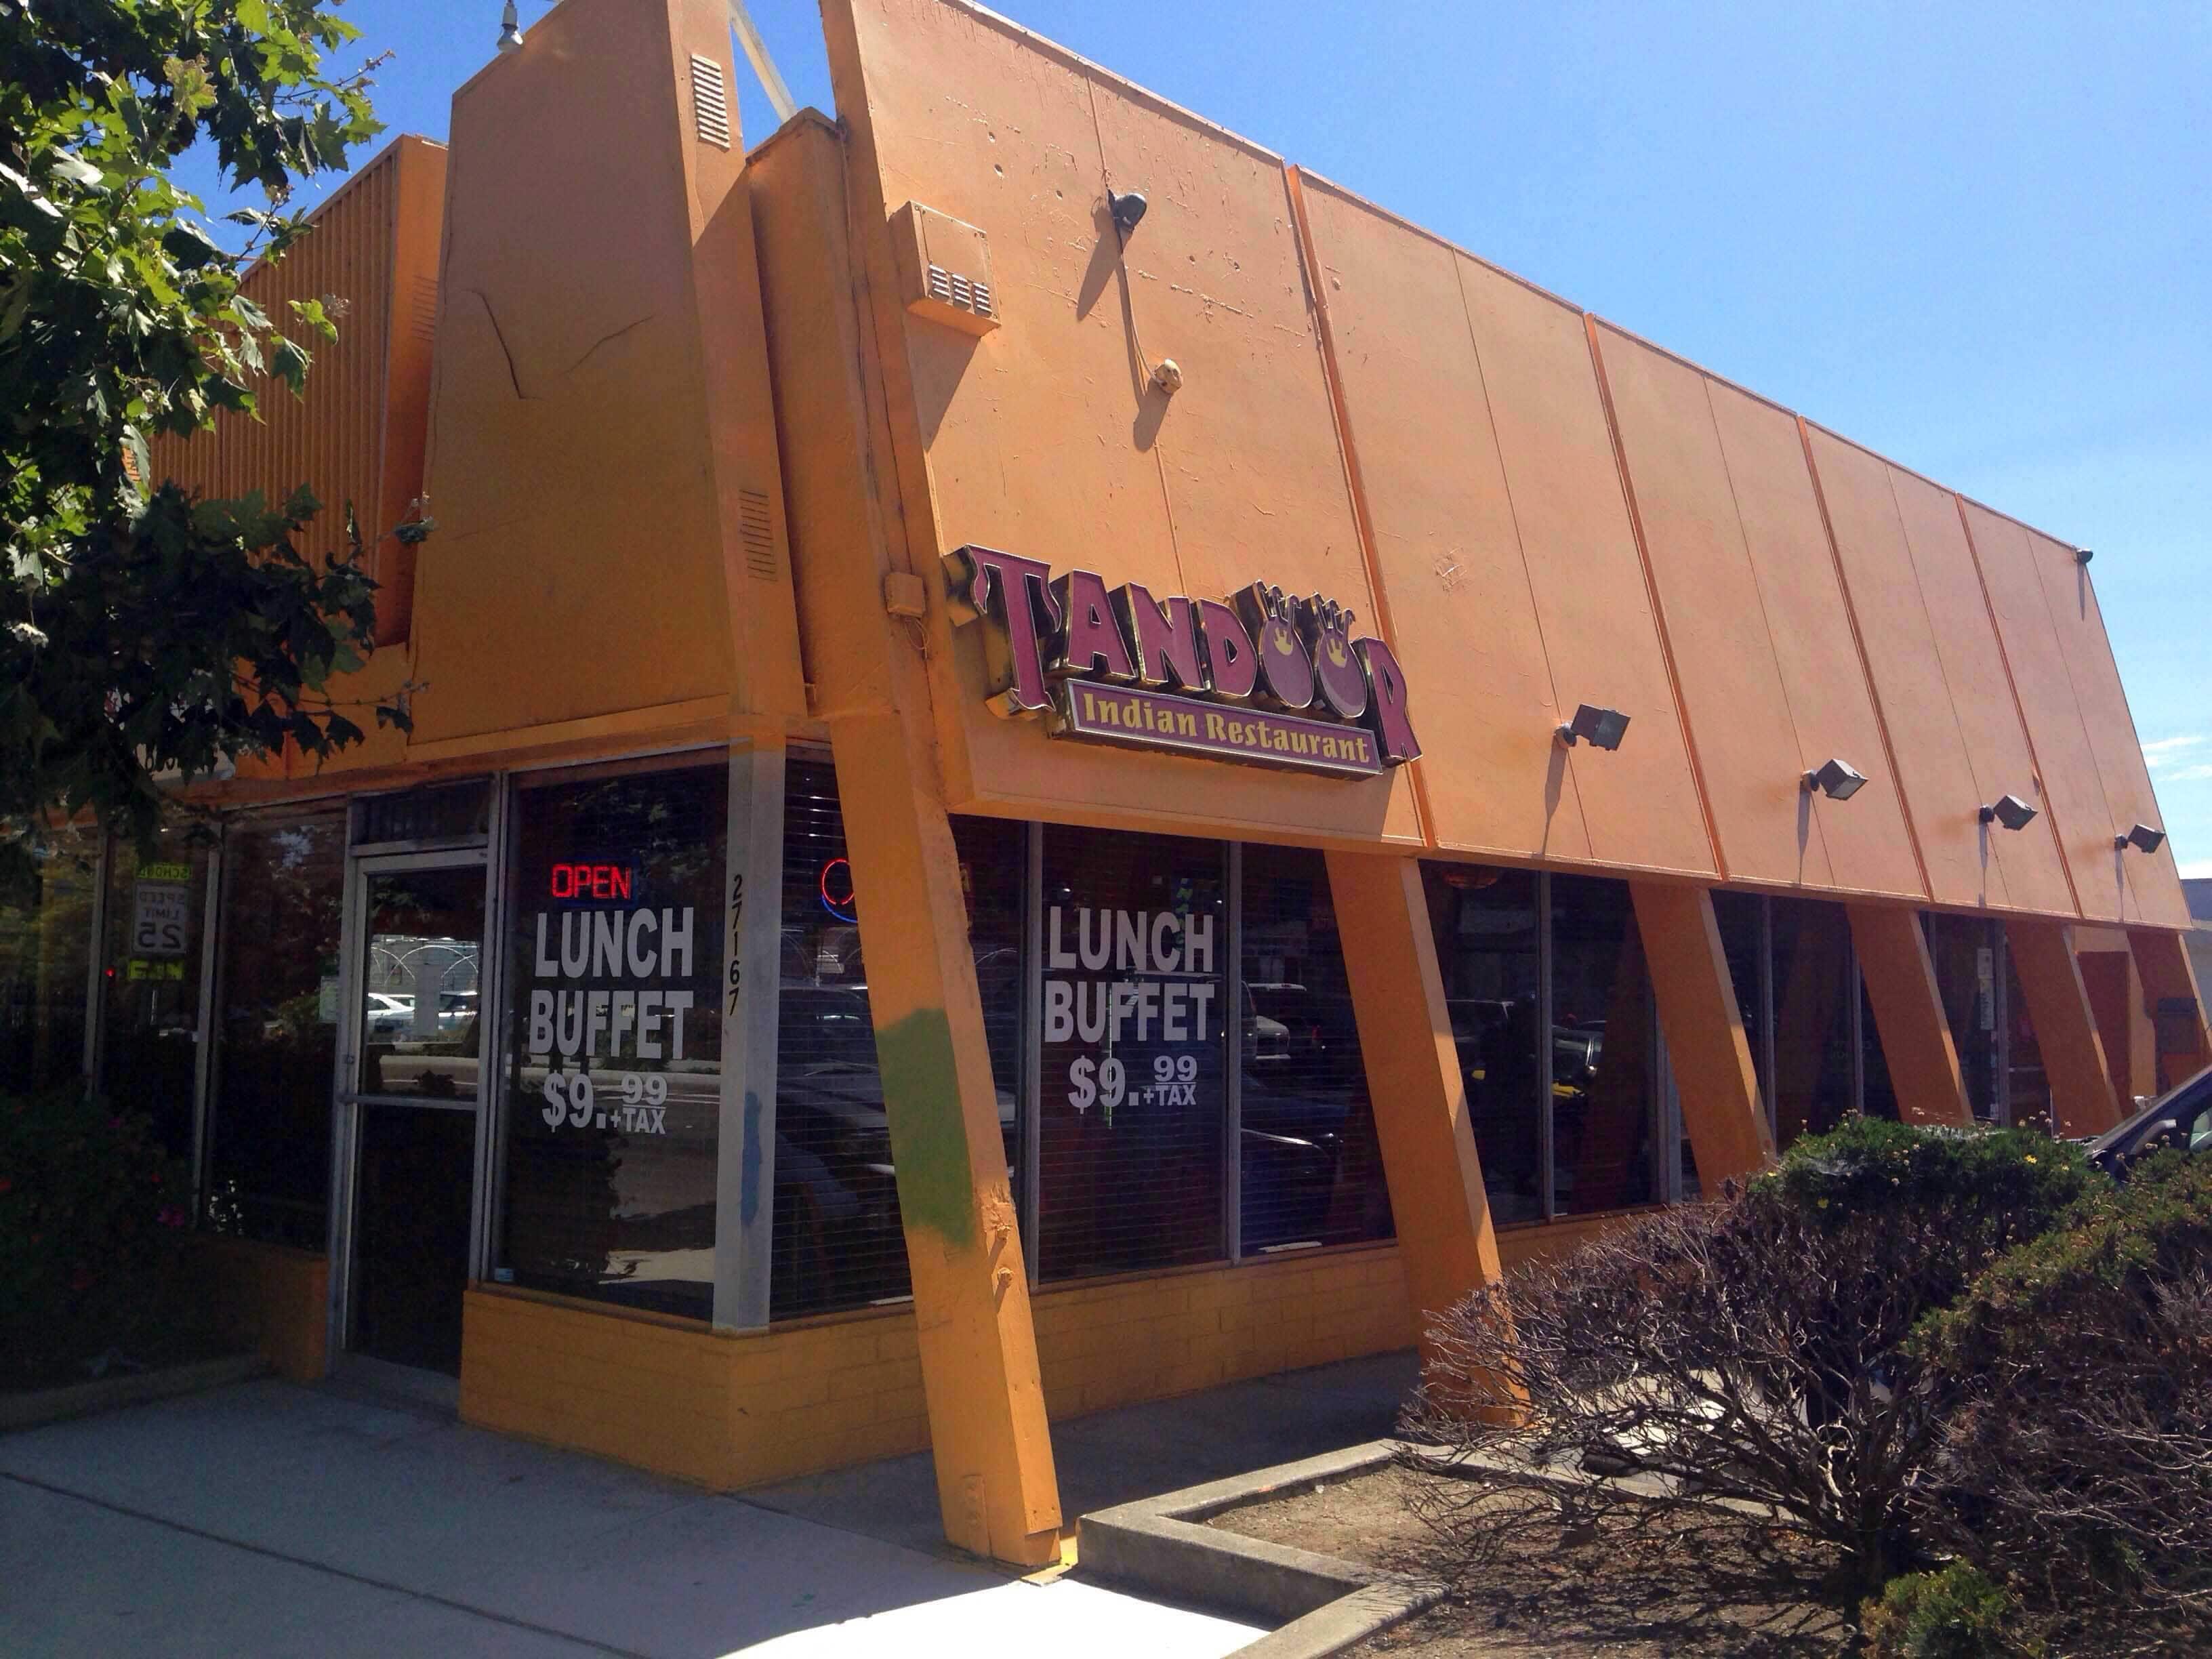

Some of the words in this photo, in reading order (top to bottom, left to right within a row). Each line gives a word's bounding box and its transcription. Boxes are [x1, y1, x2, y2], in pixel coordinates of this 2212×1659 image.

[965, 544, 1423, 762] TANDOOR
[1084, 693, 1197, 737] Indian
[1206, 714, 1370, 763] Restaurant
[552, 863, 631, 899] OPEN
[535, 907, 694, 978] LUNCH
[729, 874, 743, 1015] 27167
[1049, 906, 1213, 972] LUNCH
[529, 990, 693, 1059] BUFFET
[1044, 981, 1214, 1042] BUFFET
